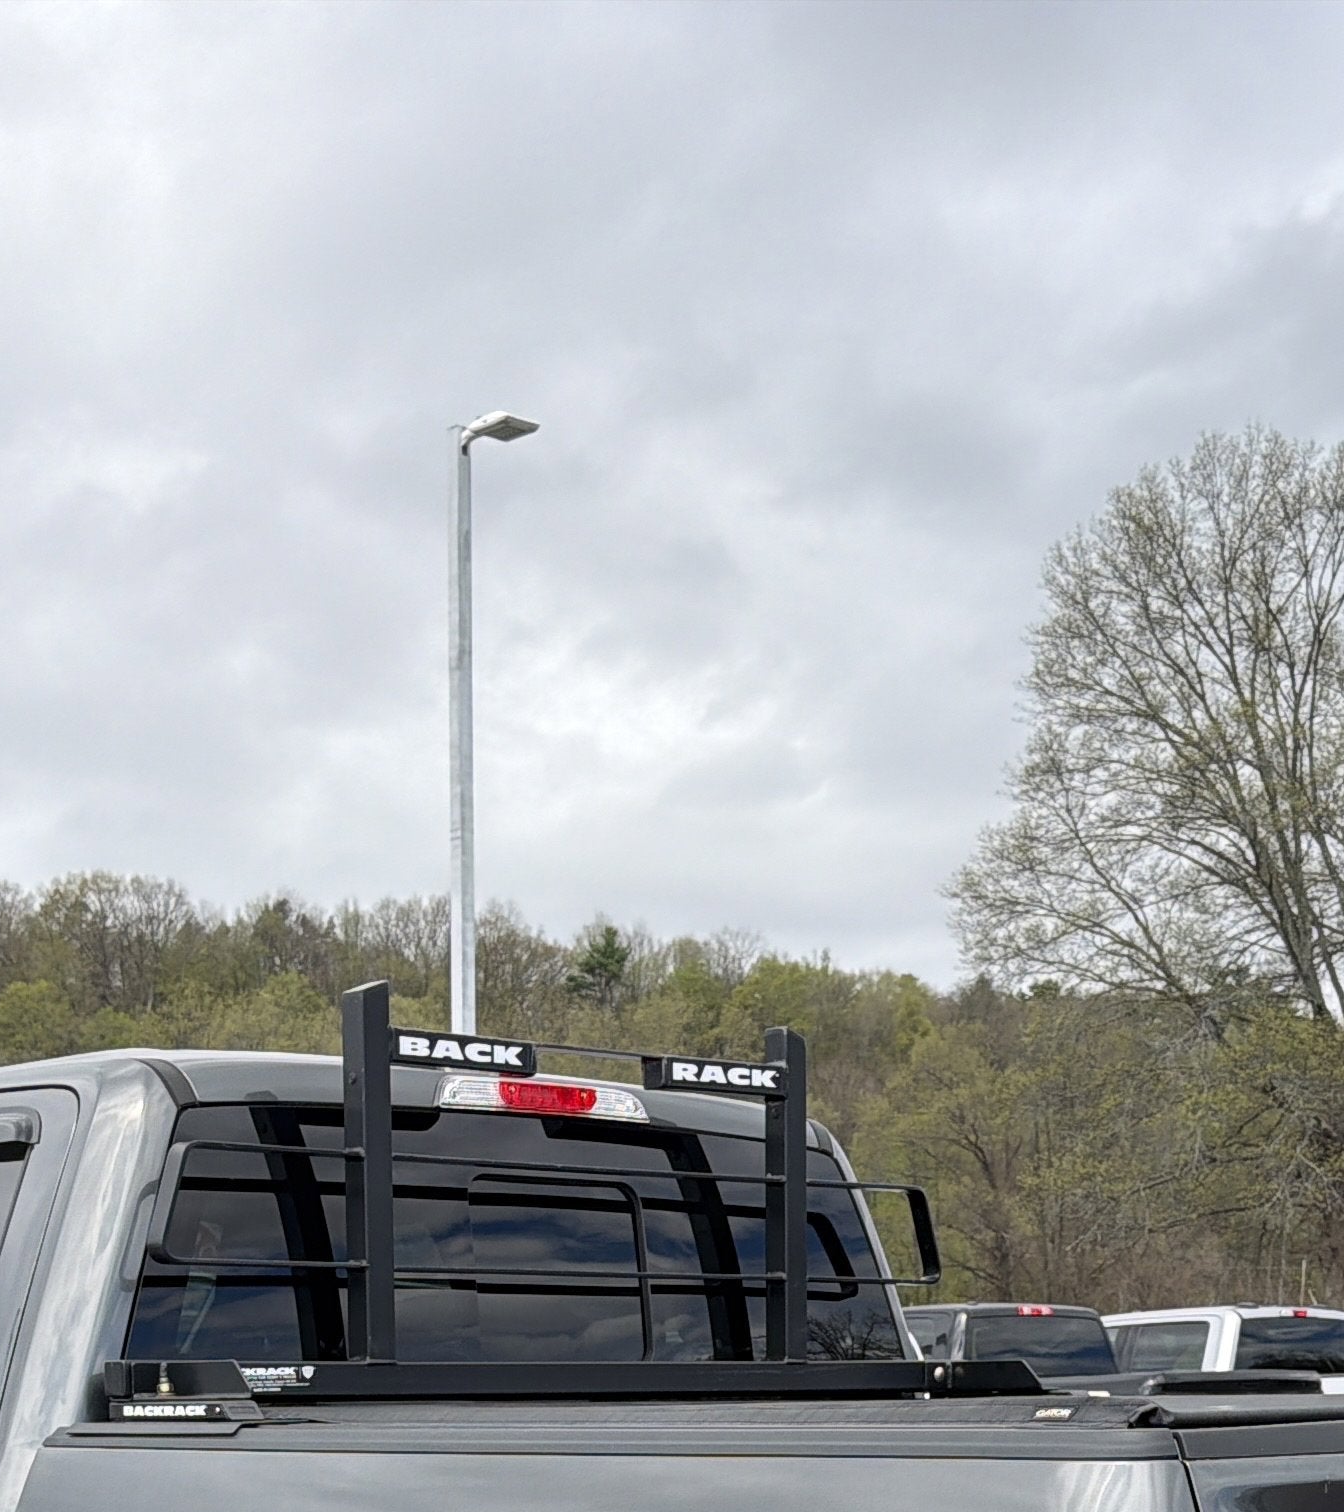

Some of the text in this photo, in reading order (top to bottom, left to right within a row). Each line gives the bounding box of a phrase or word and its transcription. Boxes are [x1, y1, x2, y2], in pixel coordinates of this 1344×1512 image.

[399, 1036, 778, 1088] BACK RACK
[123, 1405, 207, 1416] BACKRACK
